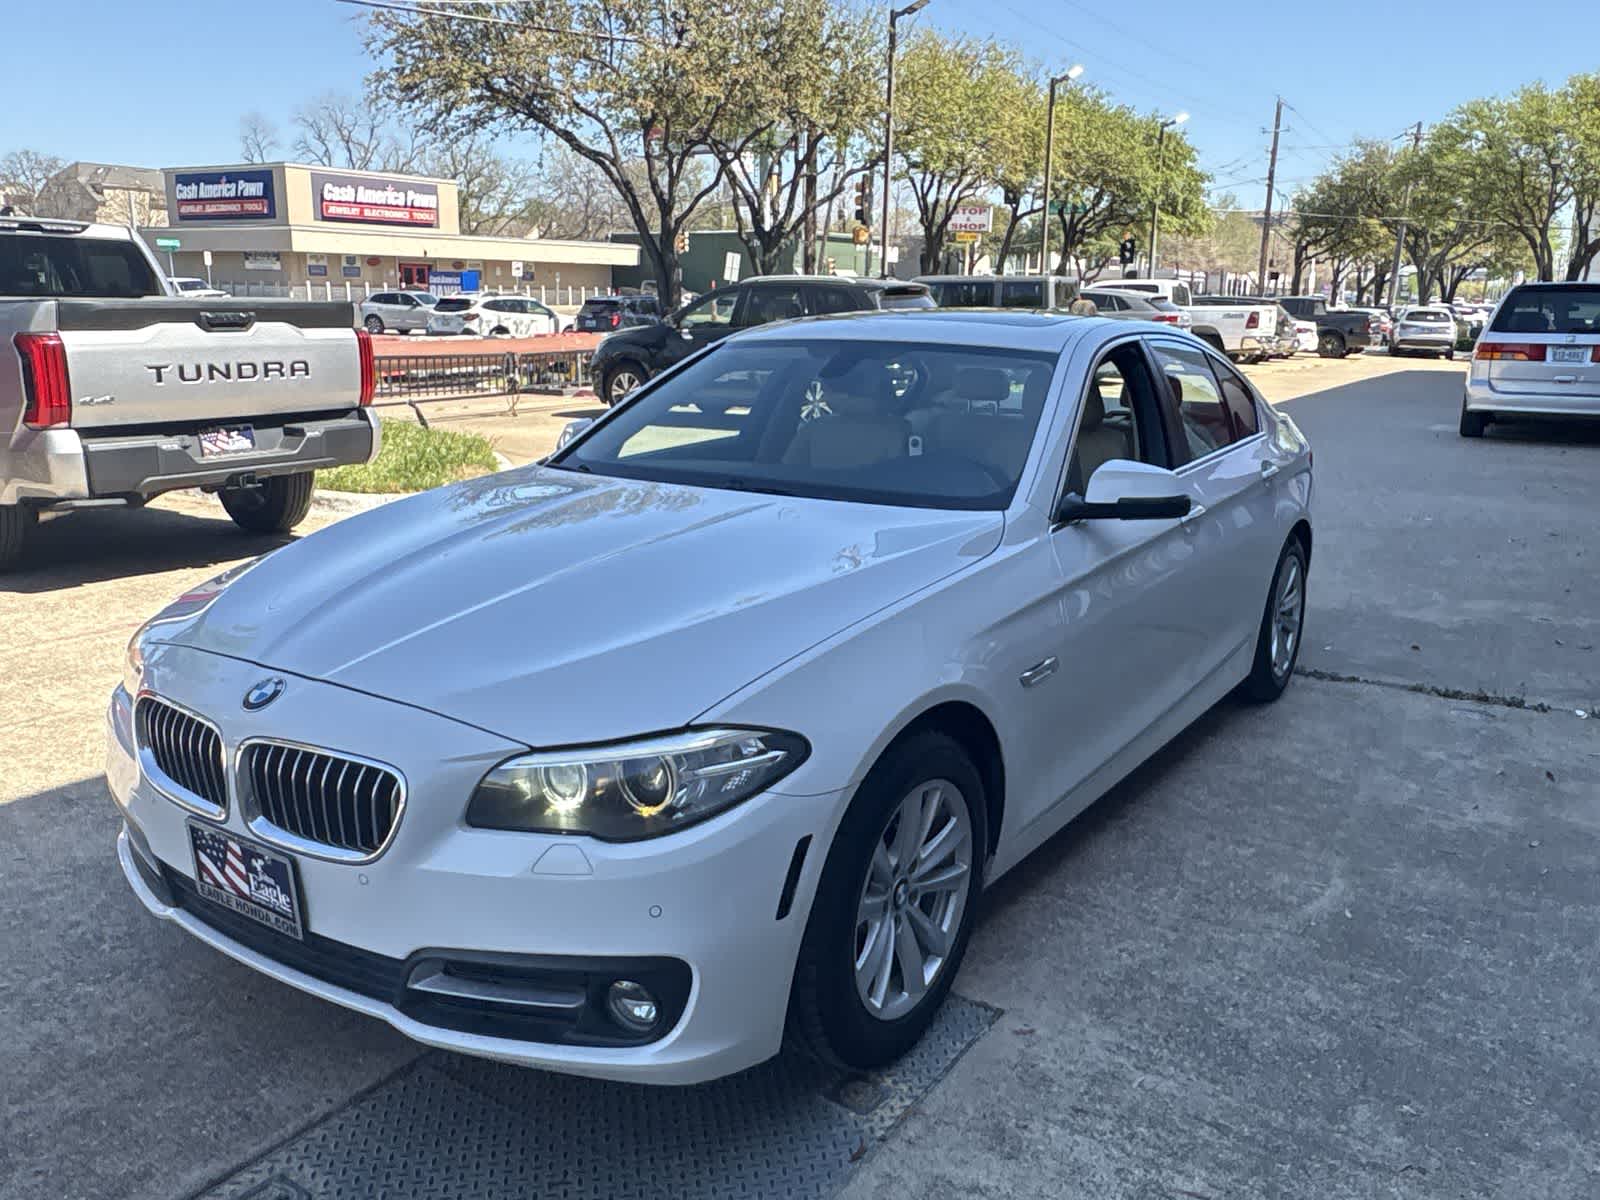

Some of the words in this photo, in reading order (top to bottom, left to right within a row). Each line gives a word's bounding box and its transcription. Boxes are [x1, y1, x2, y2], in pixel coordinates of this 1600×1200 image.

[176, 182, 198, 200] Cash
[198, 181, 237, 199] America
[237, 180, 264, 197] Pawn
[323, 182, 356, 202] Cash
[356, 185, 406, 207] America
[406, 189, 438, 208] Pawn
[327, 205, 361, 216] JEWELRY
[363, 207, 410, 219] ELECTRONICS
[412, 211, 434, 221] TOOLS
[951, 223, 986, 231] SHOP
[145, 359, 310, 385] TUNDRA
[199, 882, 233, 907] EAGLE
[248, 872, 292, 907] Eagle
